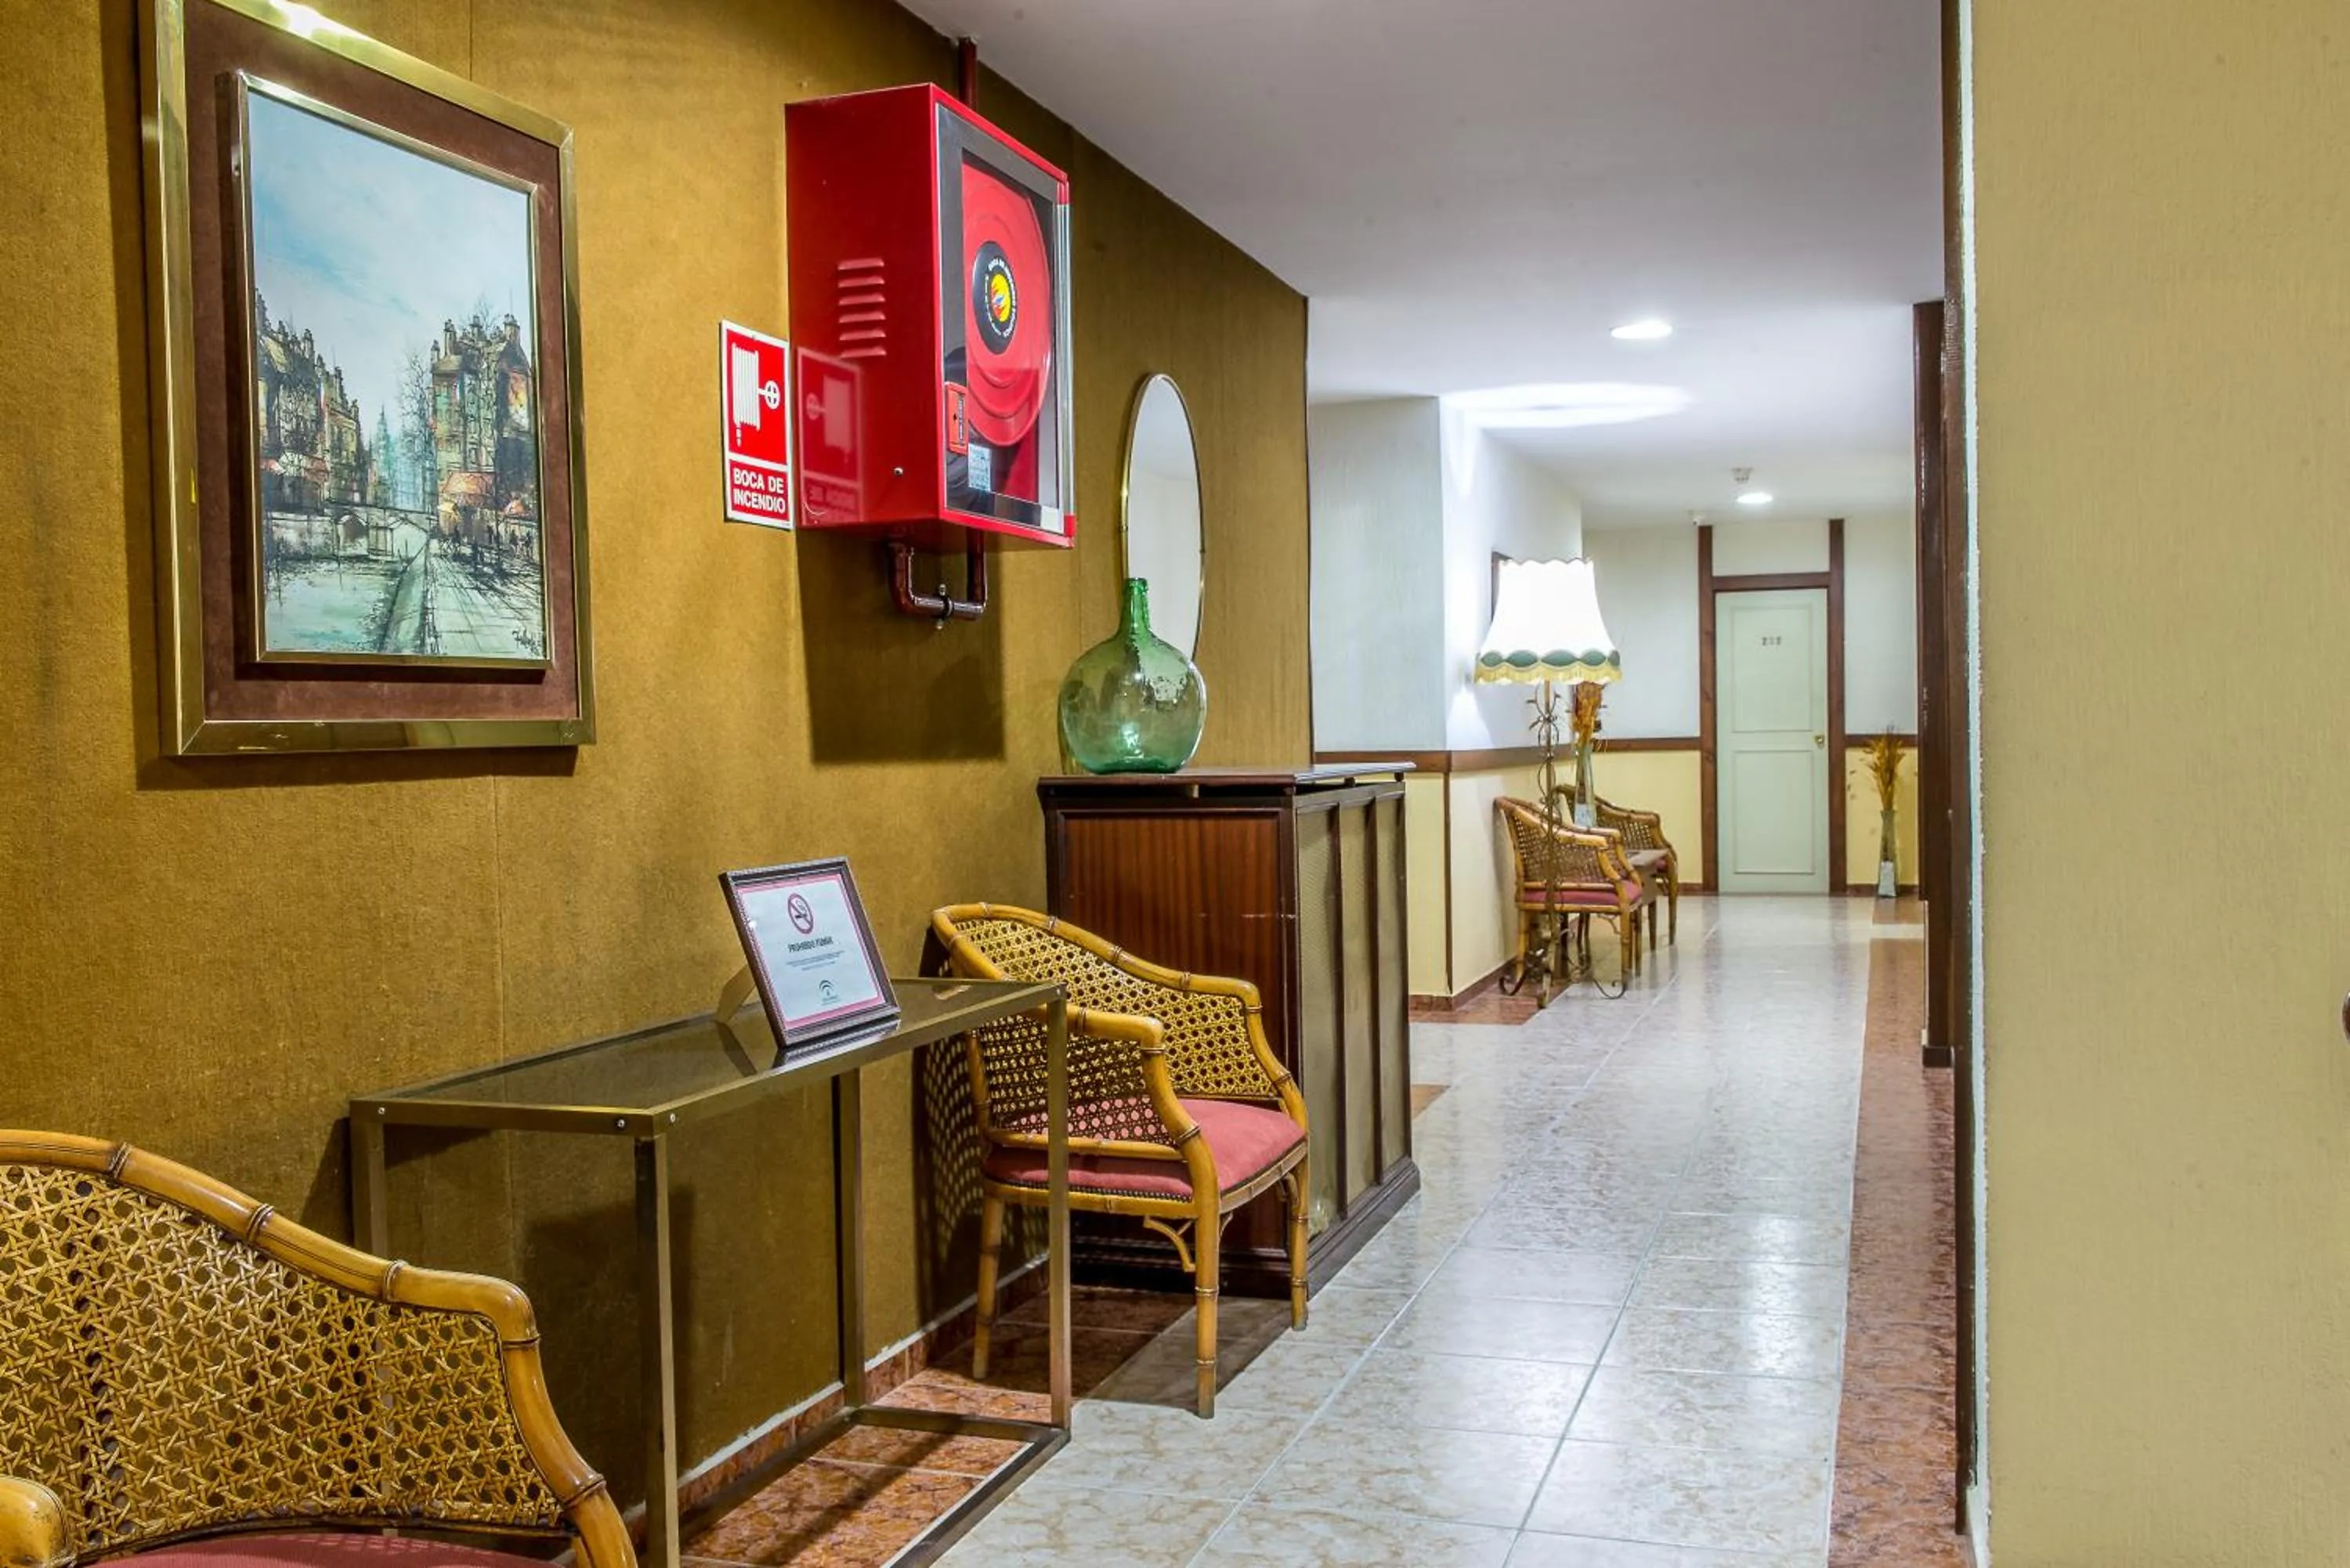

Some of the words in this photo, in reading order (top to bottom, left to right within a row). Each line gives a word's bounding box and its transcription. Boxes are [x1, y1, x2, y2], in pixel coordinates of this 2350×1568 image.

[733, 468, 765, 490] BOCA
[768, 475, 784, 494] DE
[733, 488, 786, 515] INCENDIO
